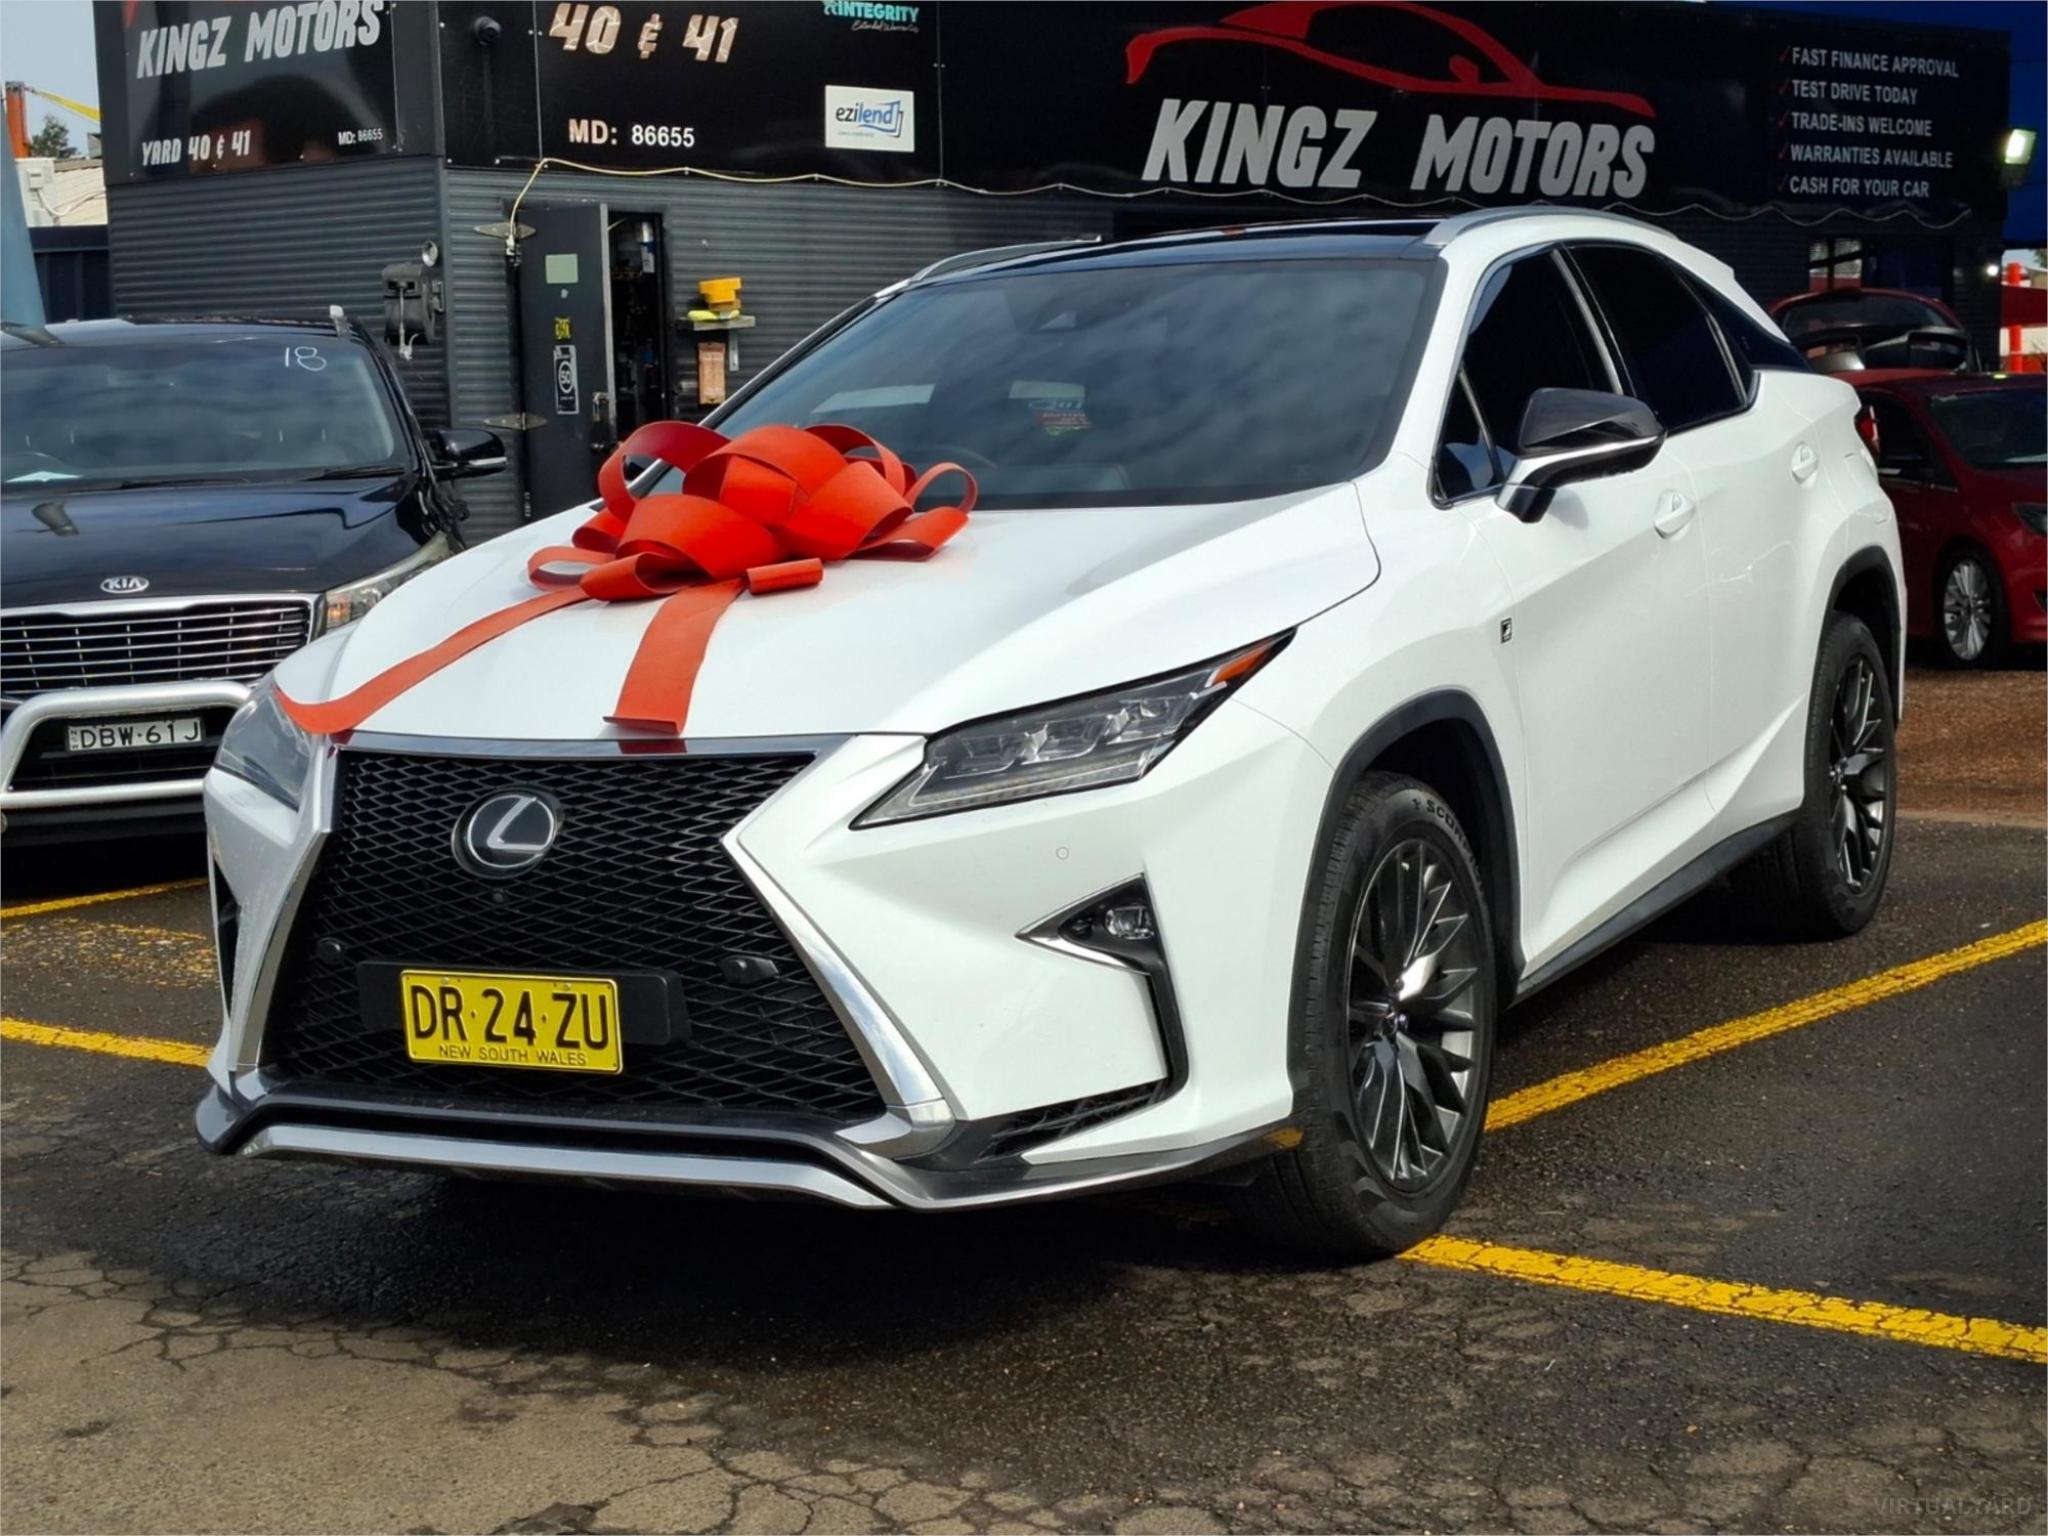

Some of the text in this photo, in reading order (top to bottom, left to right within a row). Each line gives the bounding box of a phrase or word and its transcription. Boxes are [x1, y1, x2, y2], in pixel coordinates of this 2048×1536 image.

[838, 1, 919, 22] INTEGRITY
[137, 0, 384, 78] KINGZ MOTORS
[549, 3, 622, 54] 40
[682, 15, 739, 63] 41
[1792, 47, 1959, 77] FAST FINANCE APPROVAL
[1792, 79, 1918, 105] TEST DRIVE TODAY
[836, 101, 894, 124] ezilend
[1792, 111, 1932, 137] TRADE-INS WELCOME
[338, 131, 357, 146] MD:
[569, 118, 695, 149] MD: 86655
[142, 138, 182, 166] YARD
[188, 134, 211, 160] 40
[232, 130, 251, 155] 41
[1142, 98, 1656, 198] KINGZ MOTORS
[1790, 144, 1953, 168] WARRANTIES AVAILABLE
[1790, 176, 1930, 198] CASH FOR YOUR CAR
[285, 346, 327, 372] 18
[109, 578, 141, 590] KIA
[439, 1044, 587, 1066] NEW SOUTH WALES
